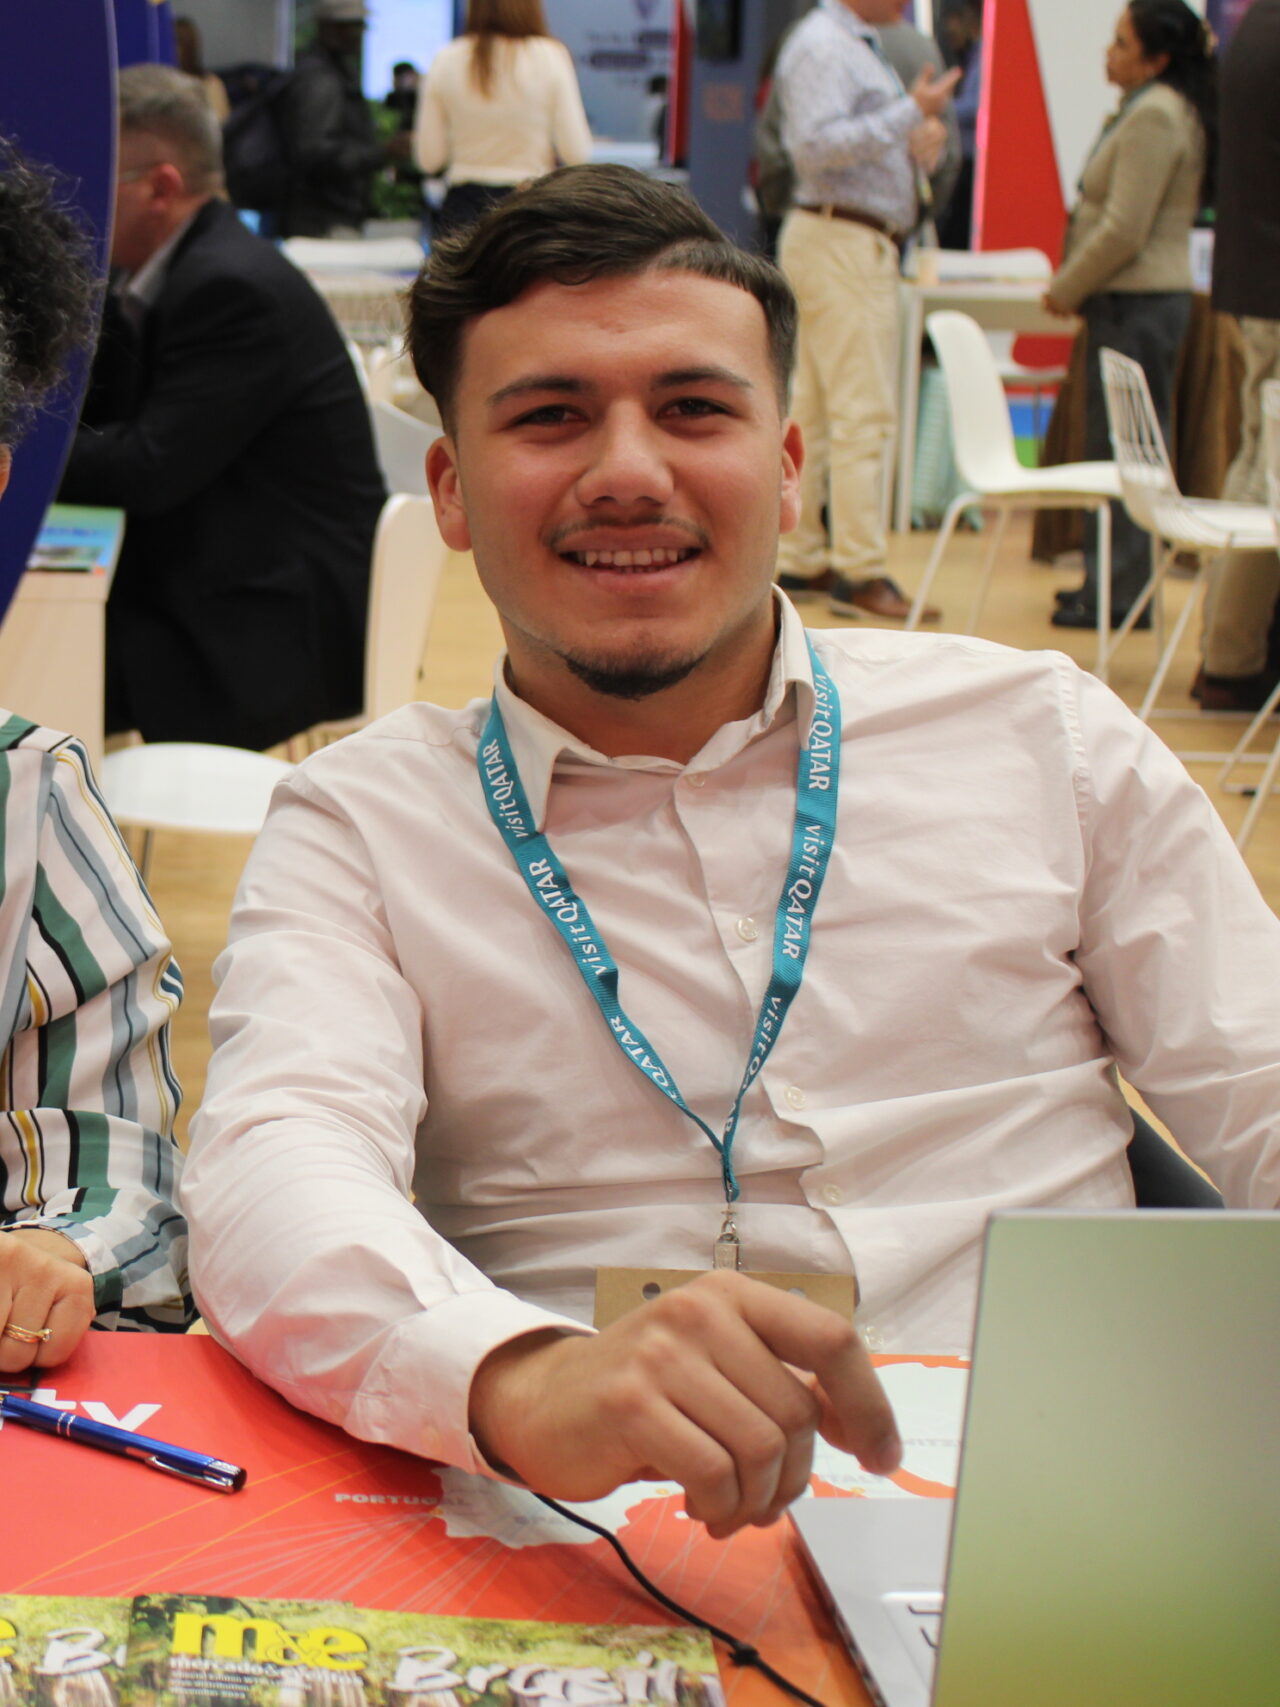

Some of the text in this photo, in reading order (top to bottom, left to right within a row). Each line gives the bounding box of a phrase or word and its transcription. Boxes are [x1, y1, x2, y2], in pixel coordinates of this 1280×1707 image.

[482, 738, 529, 838] visitQATAR
[808, 672, 833, 792] visitQATAR
[529, 857, 608, 976] visitQATAR
[782, 824, 825, 960] visitQATAR
[171, 1611, 369, 1672] m&e
